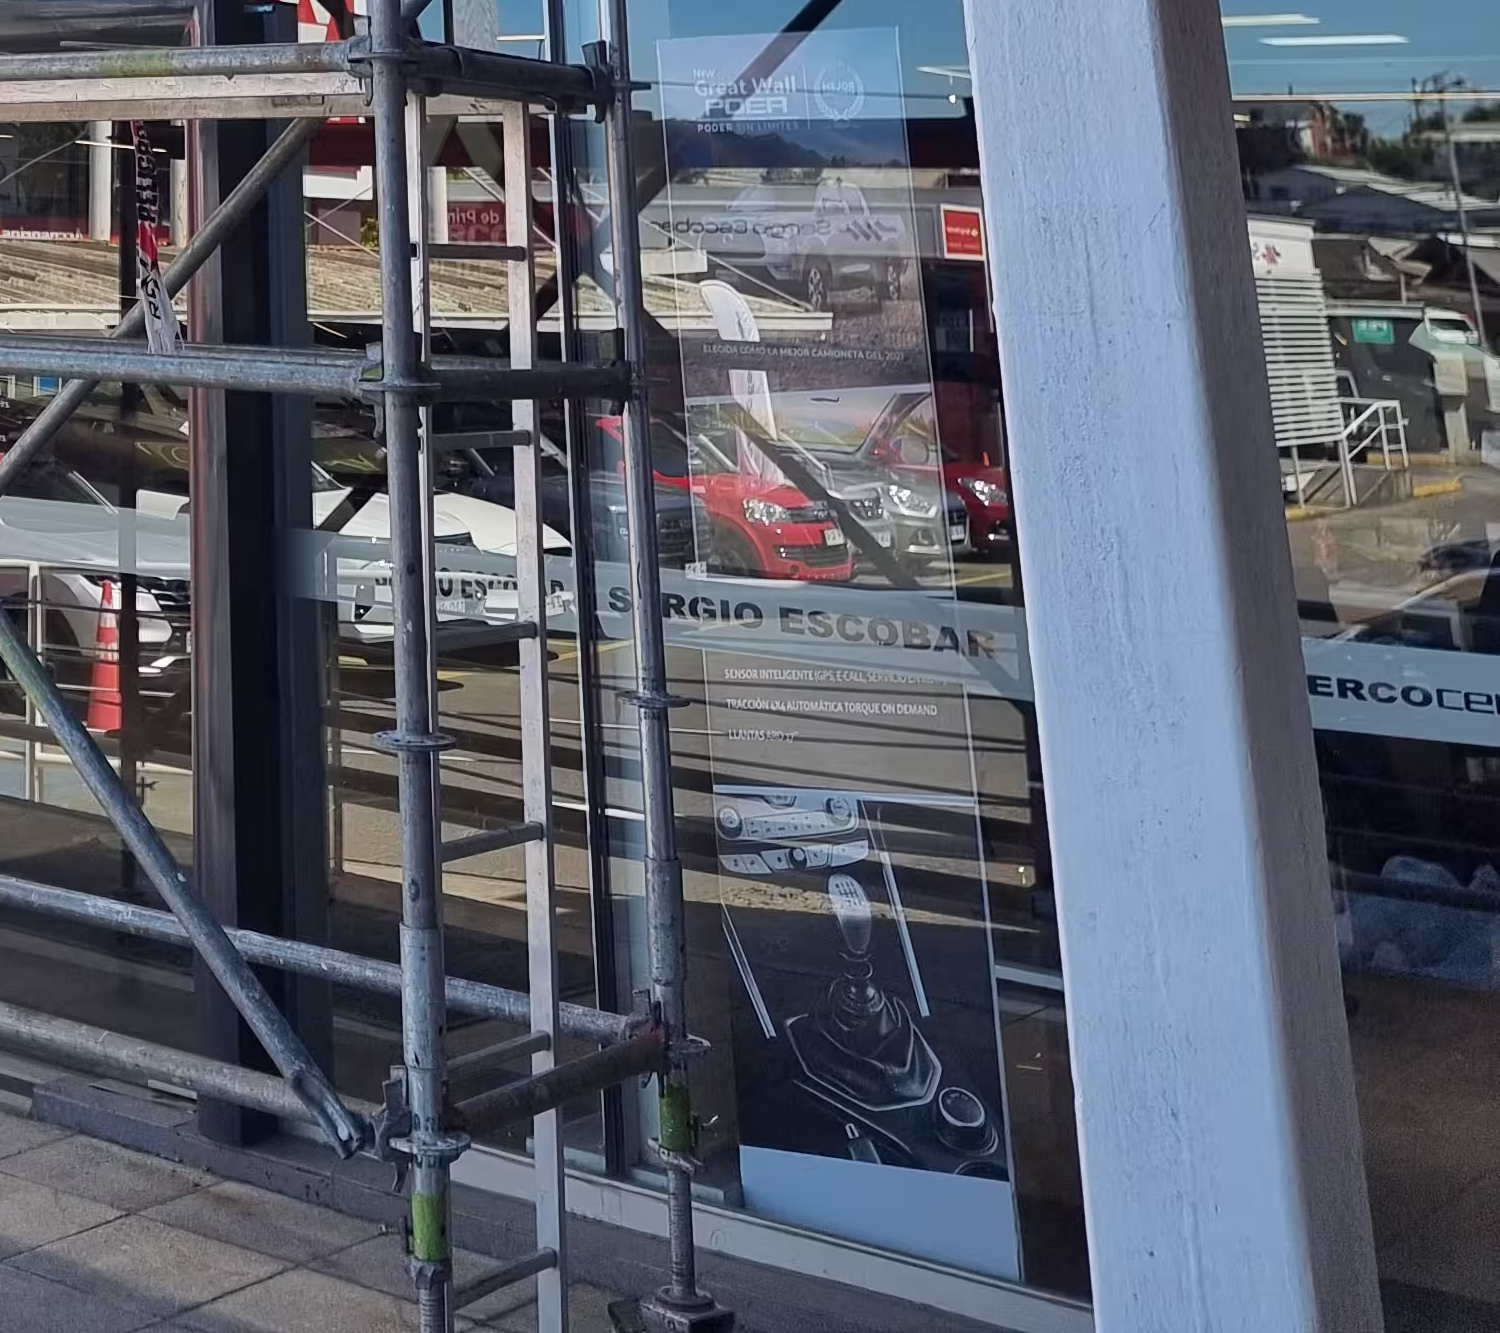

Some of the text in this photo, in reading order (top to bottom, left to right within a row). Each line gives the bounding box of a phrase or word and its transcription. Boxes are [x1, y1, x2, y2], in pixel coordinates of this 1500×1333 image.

[694, 75, 796, 97] Great Wall
[704, 96, 788, 116] POER
[697, 122, 733, 133] PODER
[780, 347, 810, 357] MEJOR
[811, 348, 864, 359] CAMIONETA
[608, 585, 996, 660] SRGIO ESCOBAR
[724, 668, 758, 680] SENSOR
[759, 668, 814, 681] INTELIGENTE
[725, 697, 769, 710] TRACCIÓN
[786, 698, 844, 713] AUTOMÁTICA
[844, 702, 880, 716] TORQUE
[881, 704, 895, 714] ON
[897, 703, 938, 716] DEMAND
[728, 729, 765, 741] LLANTAS
